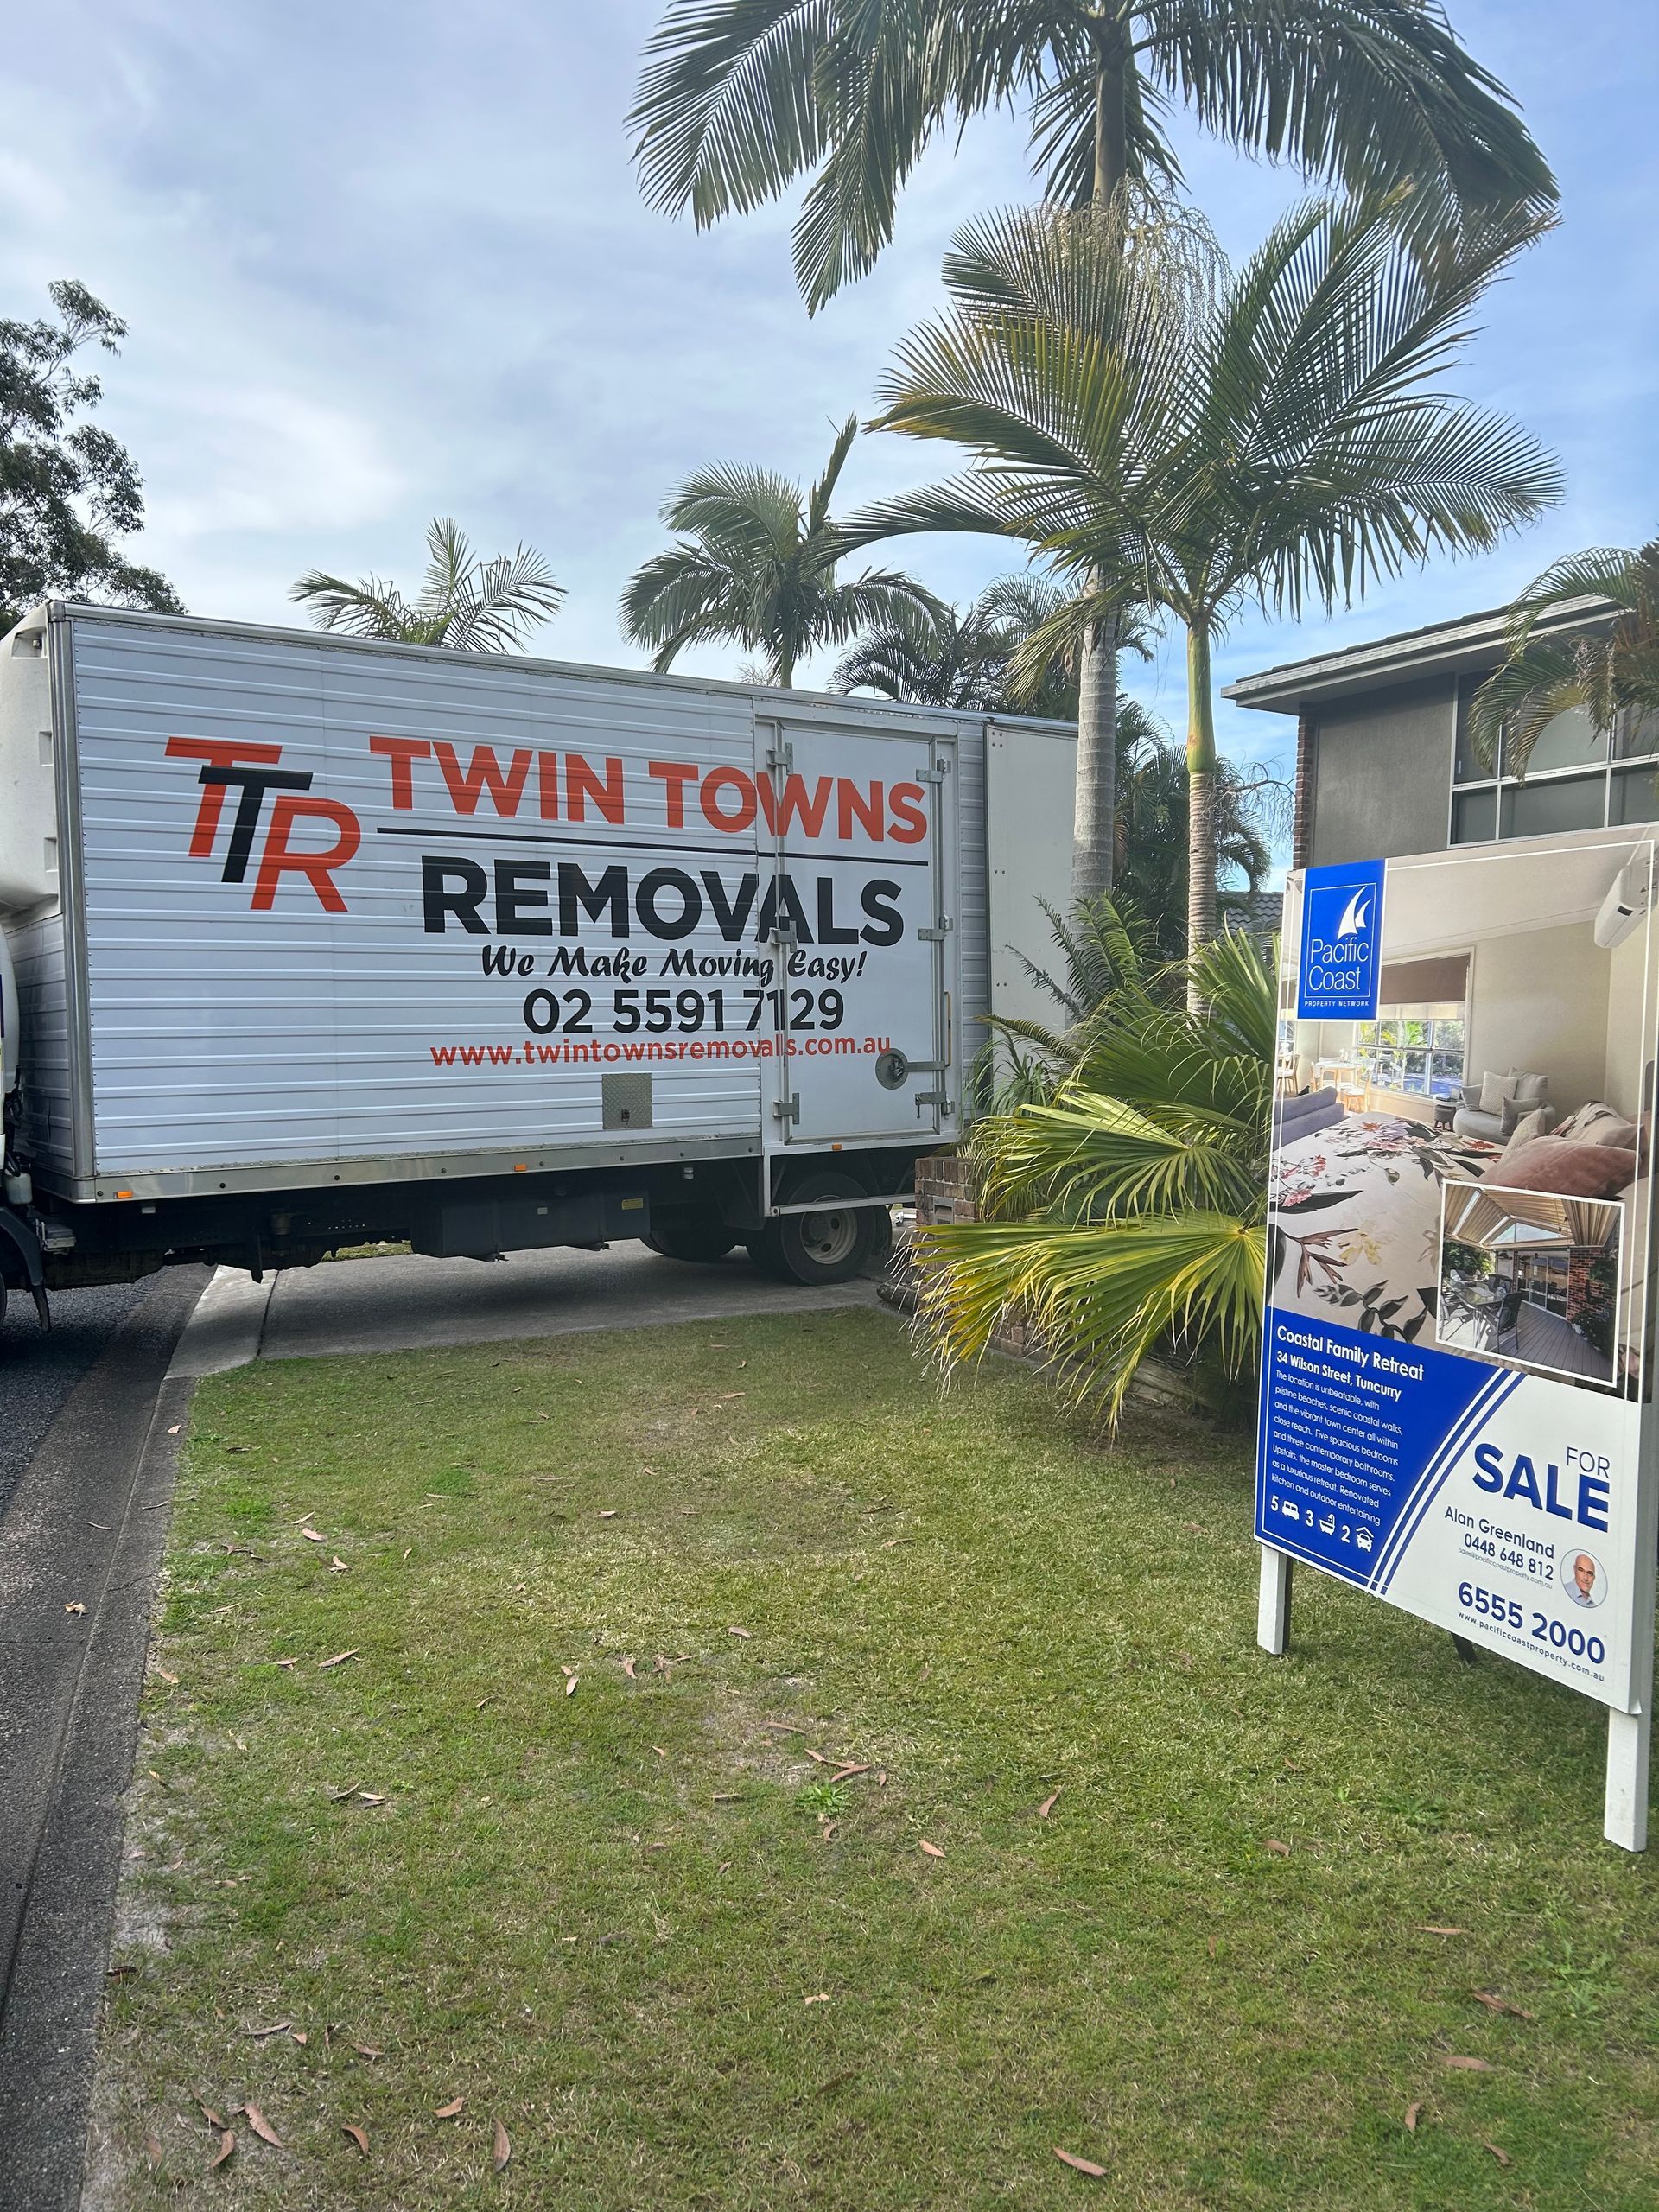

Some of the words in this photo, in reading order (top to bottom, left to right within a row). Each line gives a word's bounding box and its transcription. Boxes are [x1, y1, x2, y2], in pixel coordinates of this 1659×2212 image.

[369, 735, 626, 825] TWIN
[648, 760, 927, 843] TOWNS
[421, 855, 904, 946] REMOVALS
[482, 945, 534, 976] We
[547, 946, 647, 983] Make
[659, 949, 774, 987] Moving
[787, 950, 867, 983] Easy!
[1311, 937, 1369, 963] Pacific
[1309, 965, 1361, 990] Coast
[523, 988, 593, 1034] 02
[613, 989, 724, 1033] 5591
[743, 988, 844, 1031] 7129
[430, 1034, 891, 1065] www.twintownsremovals.com.au
[1277, 1325, 1323, 1351] Coastal
[1326, 1339, 1369, 1368] Family
[1373, 1351, 1424, 1381] Retreat
[1277, 1351, 1287, 1363] 34
[1290, 1355, 1320, 1374] Wilson
[1322, 1364, 1353, 1386] Street,
[1356, 1375, 1402, 1402] Tuncurry
[1275, 1386, 1297, 1399] pristine
[1330, 1404, 1352, 1417] scenic
[1353, 1413, 1380, 1427] coastal
[1276, 1370, 1287, 1380] The
[1287, 1374, 1313, 1389] location
[1315, 1382, 1319, 1391] is
[1364, 1400, 1379, 1410] with
[1274, 1402, 1287, 1410] and
[1288, 1404, 1300, 1414] the
[1300, 1409, 1323, 1423] vibrant
[1325, 1417, 1341, 1429] town
[1343, 1425, 1366, 1438] center
[1376, 1436, 1398, 1449] within
[1274, 1415, 1290, 1427] close
[1315, 1429, 1328, 1441] Five
[1329, 1435, 1359, 1452] spacious
[1361, 1446, 1398, 1465] bedrooms
[1274, 1431, 1286, 1440] and
[1287, 1434, 1304, 1447] three
[1305, 1442, 1353, 1467] contemporary
[1299, 1453, 1310, 1465] the
[1311, 1460, 1333, 1474] master
[1334, 1468, 1368, 1486] bedroom
[1369, 1482, 1391, 1497] serves
[1566, 1446, 1610, 1478] FOR
[1272, 1473, 1294, 1489] kitchen
[1295, 1484, 1309, 1495] and
[1310, 1491, 1337, 1506] outdoor
[1338, 1503, 1381, 1526] entertaining
[1287, 1464, 1313, 1481] luxurious
[1339, 1485, 1380, 1508] Renovated
[1472, 1443, 1610, 1533] SALE
[1271, 1495, 1279, 1511] 5
[1306, 1510, 1313, 1527] 3
[1341, 1525, 1350, 1543] 2
[1445, 1506, 1474, 1528] Alan
[1479, 1518, 1554, 1559] Greenland
[1465, 1533, 1495, 1556] 0448
[1500, 1548, 1523, 1568] 648
[1529, 1559, 1554, 1580] 812
[1459, 1581, 1523, 1629] 6555
[1532, 1612, 1605, 1664] 2000
[1458, 1611, 1605, 1682] www.pacificcoastproperty.com.au
